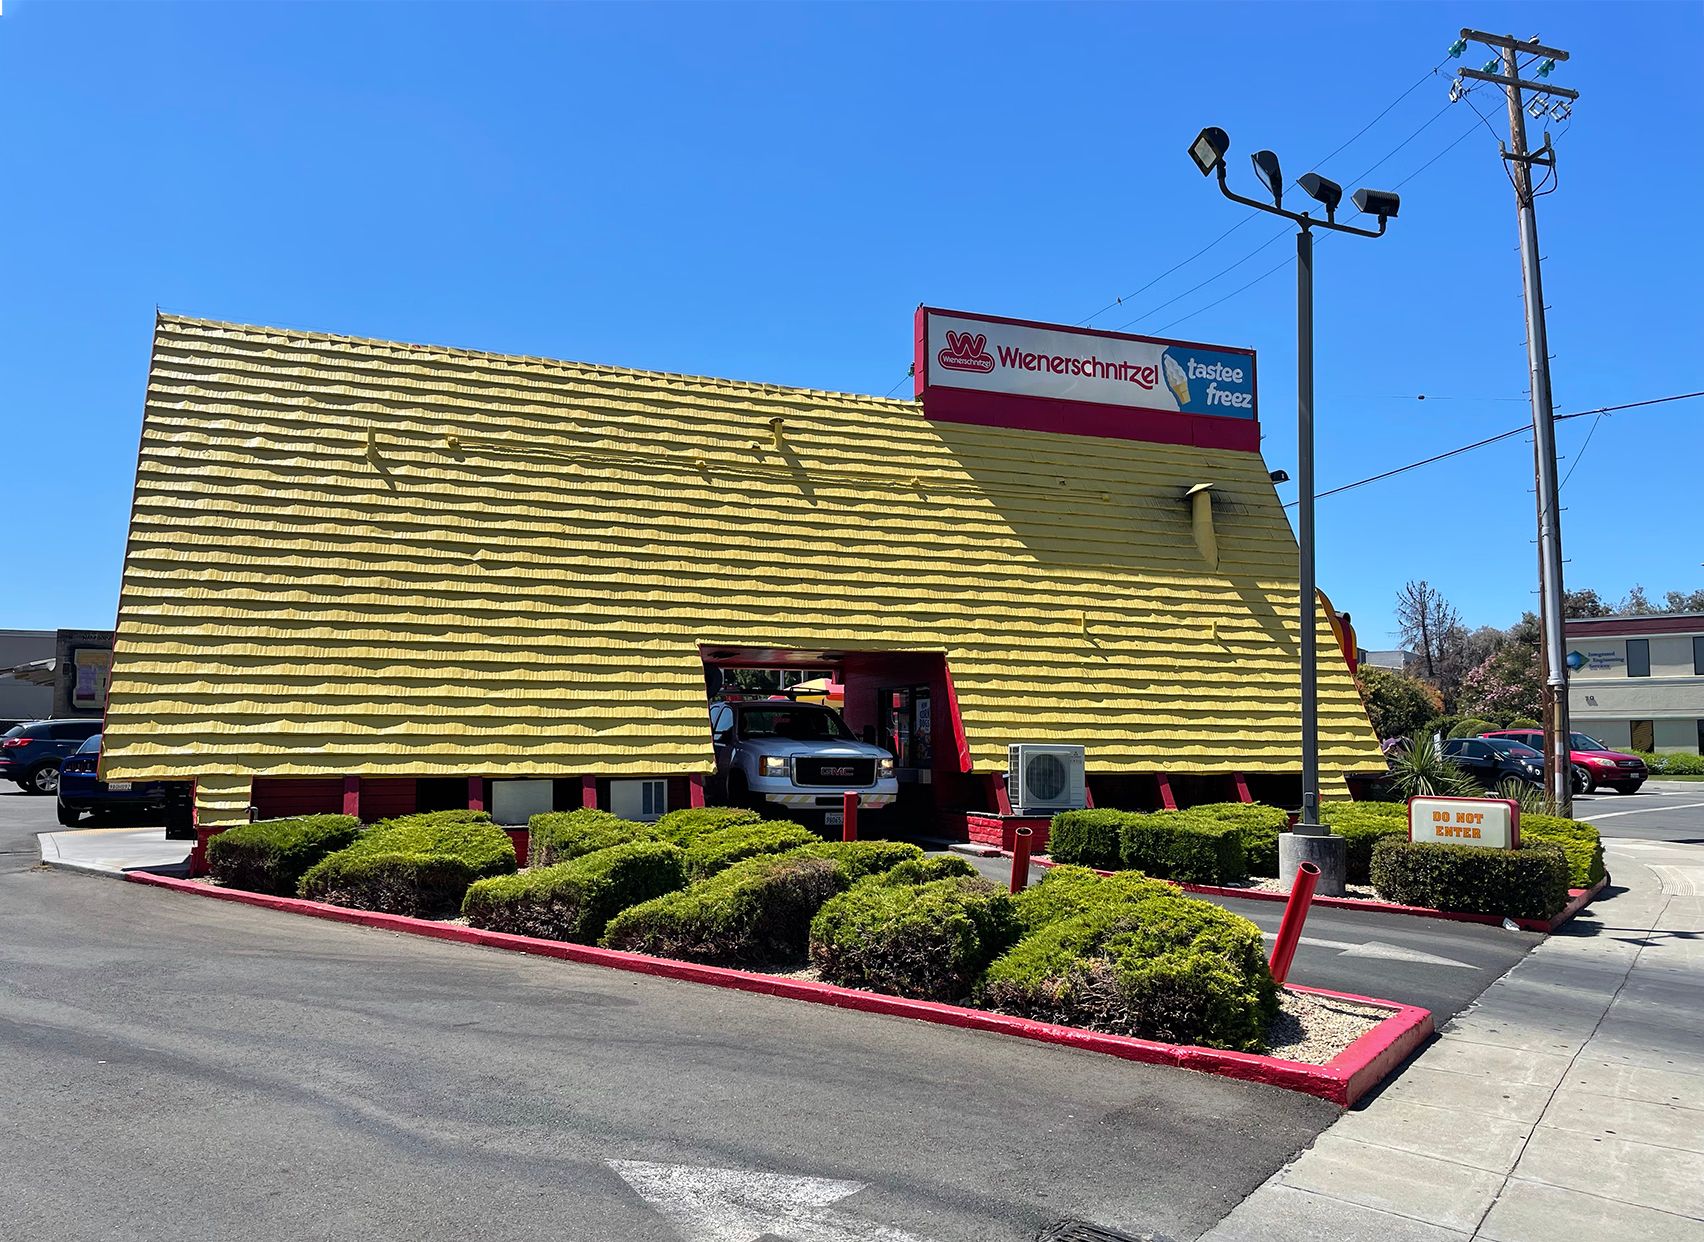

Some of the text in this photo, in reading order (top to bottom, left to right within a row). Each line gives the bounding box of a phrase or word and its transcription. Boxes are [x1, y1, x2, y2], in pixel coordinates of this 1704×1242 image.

[943, 355, 991, 369] Wienerschnitzel
[997, 345, 1159, 390] Wienerschnitzel
[1187, 357, 1244, 383] tastee
[1206, 381, 1252, 408] freez
[820, 766, 854, 776] GMC
[1432, 811, 1483, 824] DO NOT
[1435, 826, 1481, 838] ENTER
